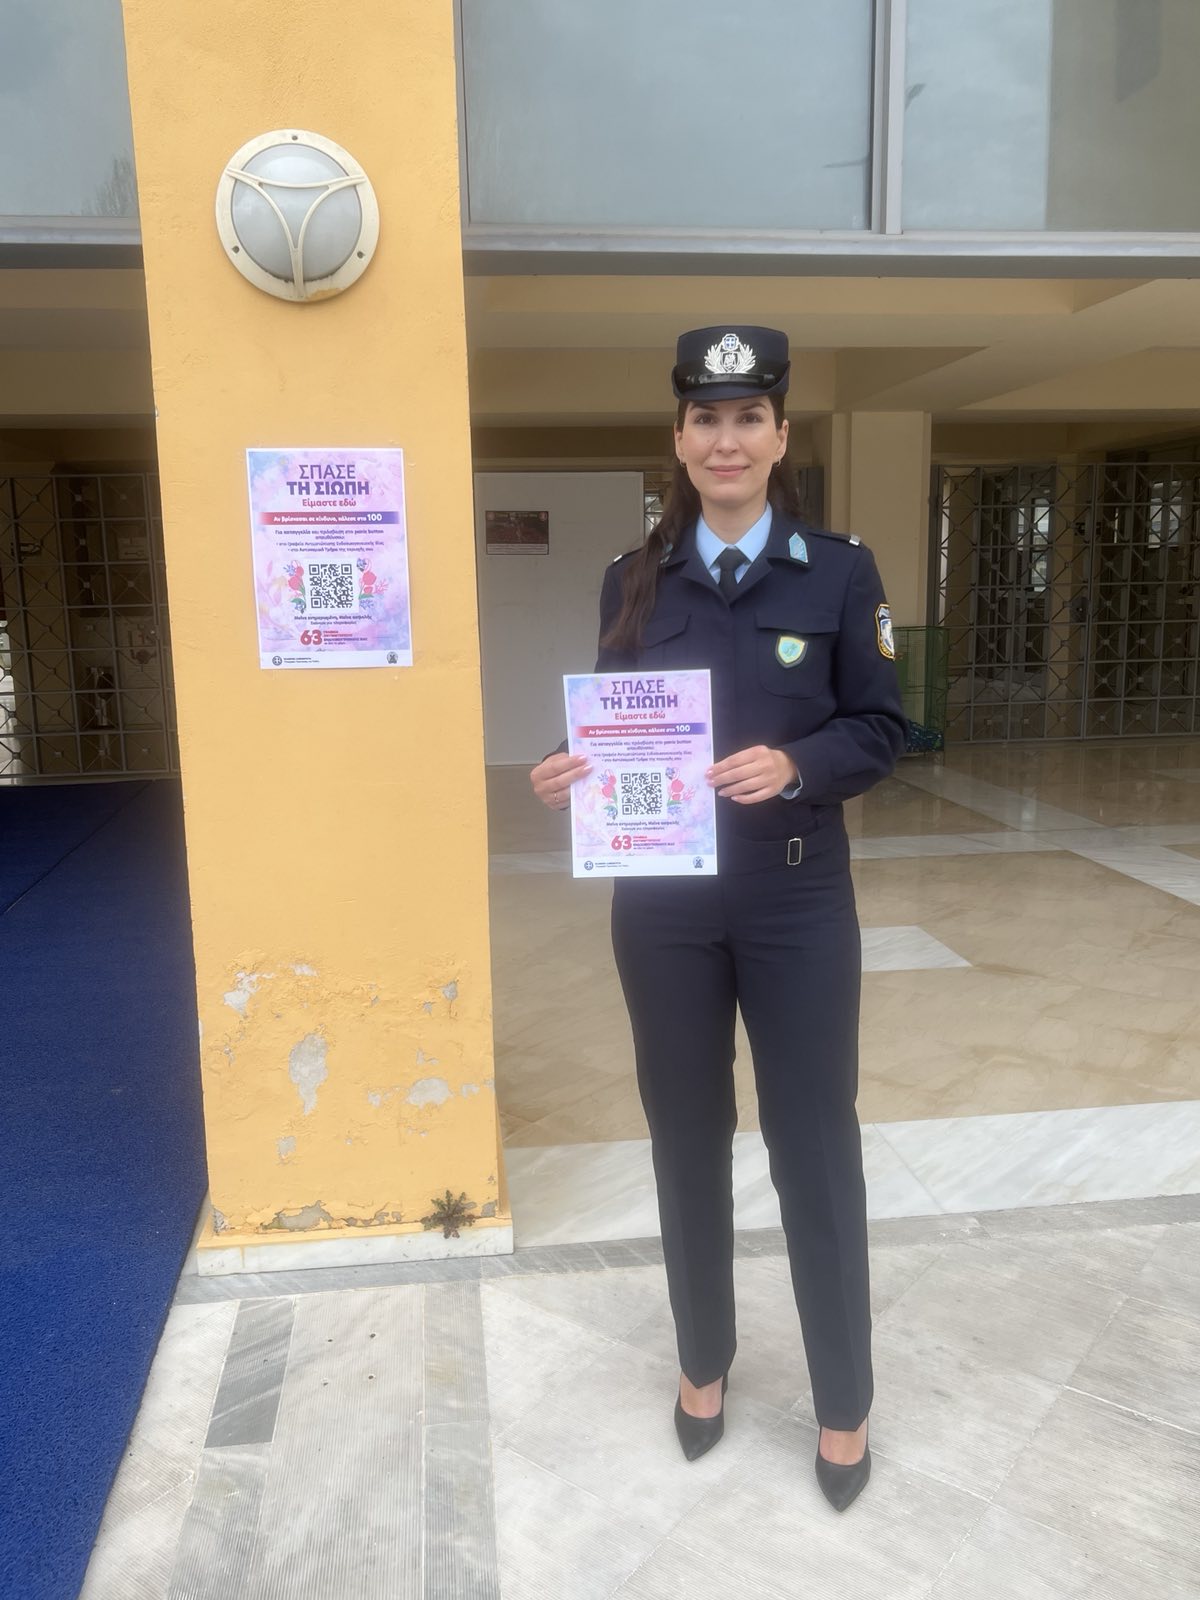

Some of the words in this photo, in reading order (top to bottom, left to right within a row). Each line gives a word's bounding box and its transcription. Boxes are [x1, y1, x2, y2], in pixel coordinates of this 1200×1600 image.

[298, 464, 356, 479] ΣΠΑΣΕ
[286, 481, 311, 496] ΤΗ
[314, 481, 370, 496] ΣΙΩΠΗ
[302, 498, 337, 508] Είμαστε
[339, 498, 357, 507] εδώ
[367, 513, 382, 522] 100
[300, 629, 322, 645] 63
[611, 680, 665, 695] ΣΠΑΣΕ
[600, 696, 622, 710] ΤΗ
[626, 695, 678, 709] ΣΙΩΠΗ
[615, 711, 647, 721] Είμαστε
[649, 710, 666, 720] εδώ
[676, 724, 690, 732] 100
[610, 834, 632, 850] 63
